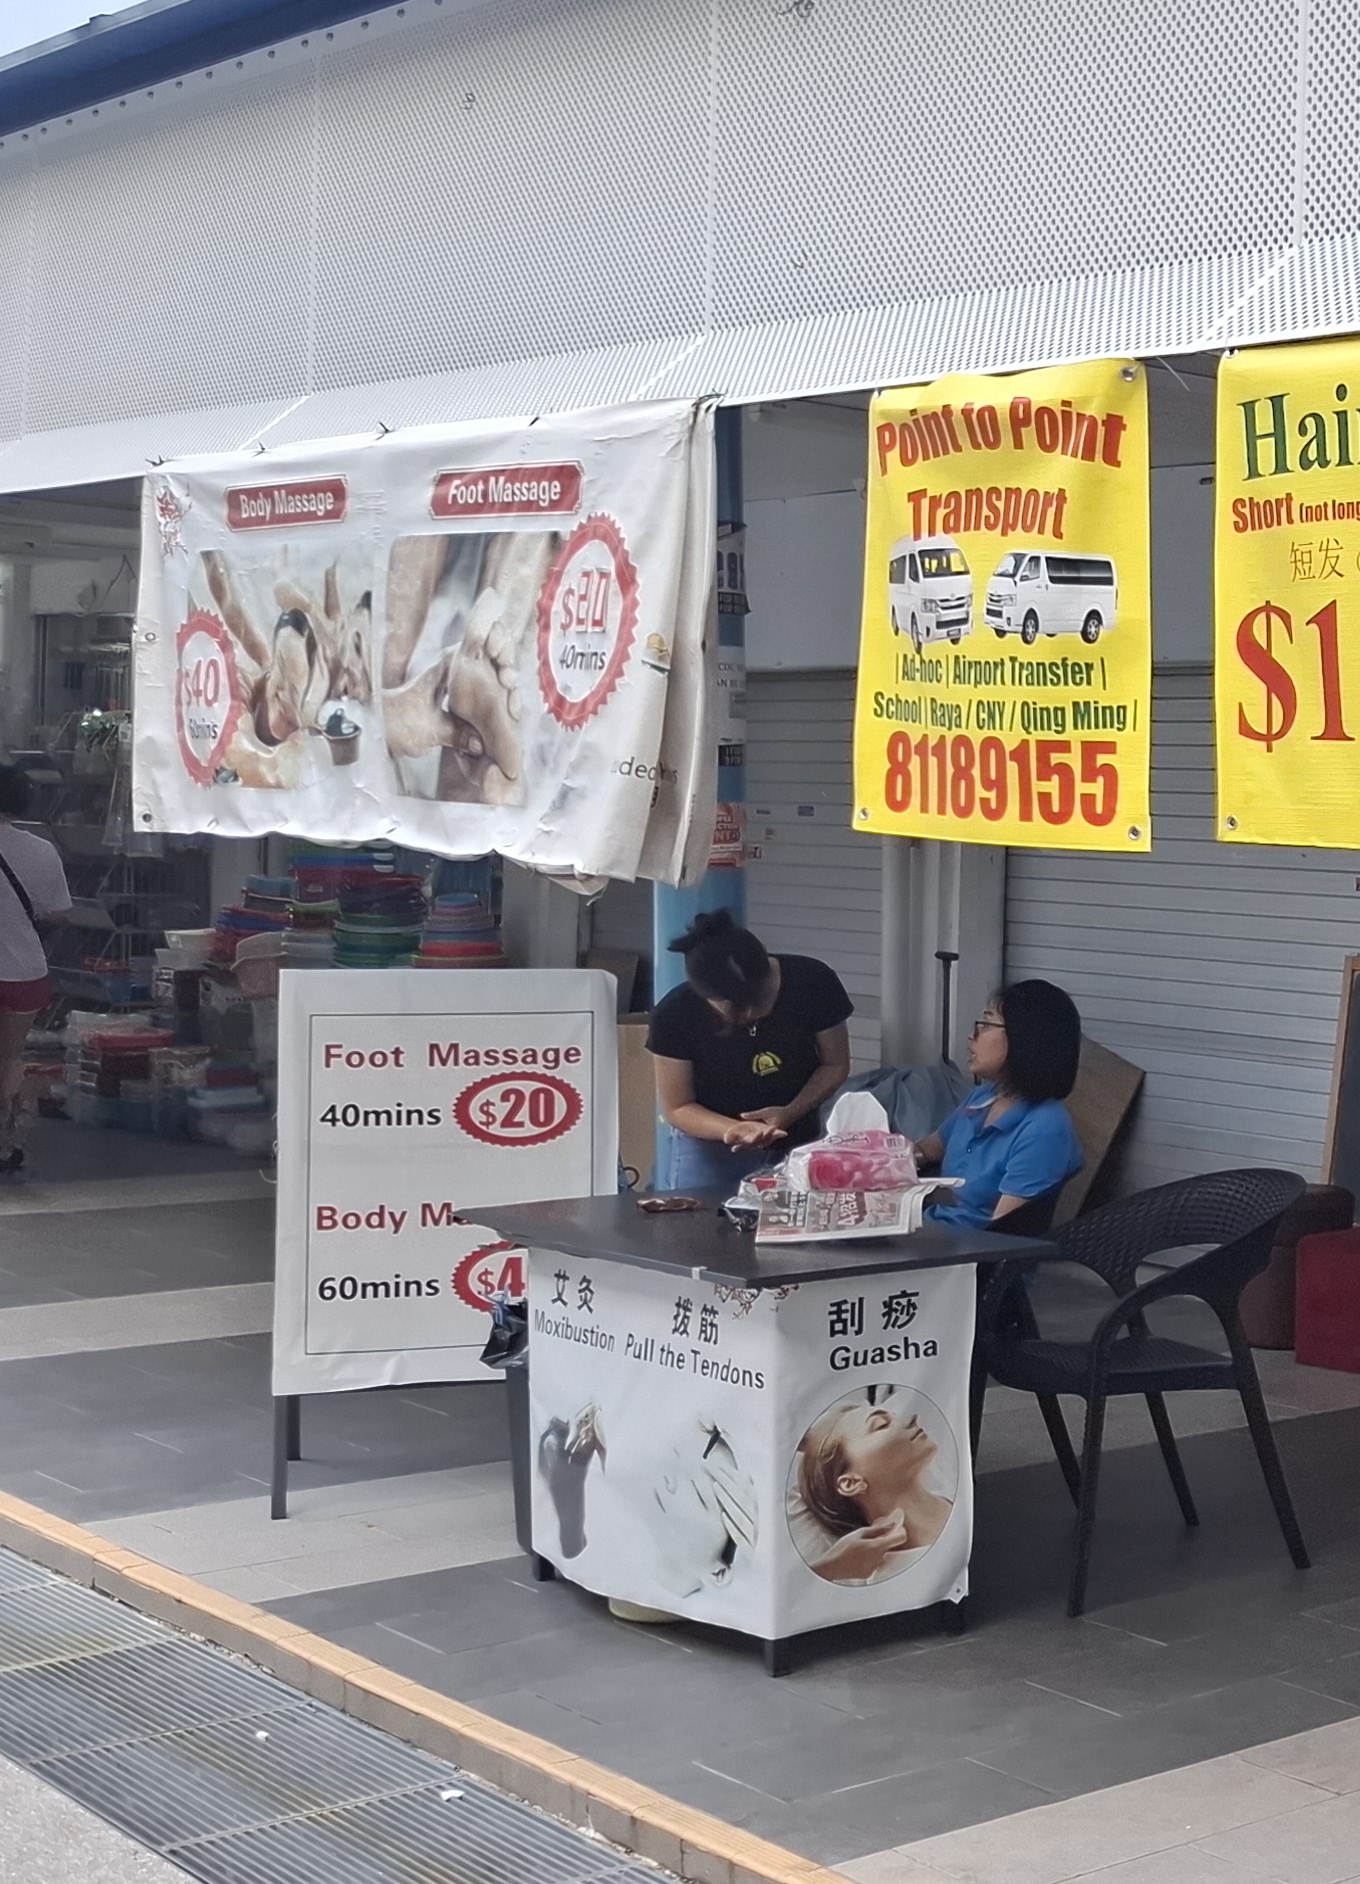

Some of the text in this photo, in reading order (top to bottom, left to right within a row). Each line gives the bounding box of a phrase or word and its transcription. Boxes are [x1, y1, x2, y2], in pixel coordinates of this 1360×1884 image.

[876, 396, 1128, 477] Point to Point
[239, 489, 334, 521] Body Massage
[448, 470, 562, 506] Foot Massage
[907, 485, 1068, 541] Transport
[1232, 492, 1294, 534] Short
[1299, 501, 1329, 524] (not
[559, 643, 607, 671] 40mins
[902, 653, 943, 686] Ad-hoc
[953, 653, 1006, 689] Airport
[1009, 656, 1095, 689] Transfer
[873, 691, 922, 725] School
[931, 699, 962, 731] Raya
[976, 699, 1006, 731] CNY
[1020, 700, 1064, 735] Qing
[1072, 700, 1128, 732] Ming
[884, 730, 1120, 828] 81189155
[323, 1042, 583, 1071] Foot Massage
[319, 1090, 557, 1131] 40mins $20
[315, 1203, 406, 1236] Body
[317, 1274, 441, 1301] 60mins
[534, 1308, 766, 1390] Moxibustion Pull the Tendons
[829, 1335, 939, 1371] Guasha
